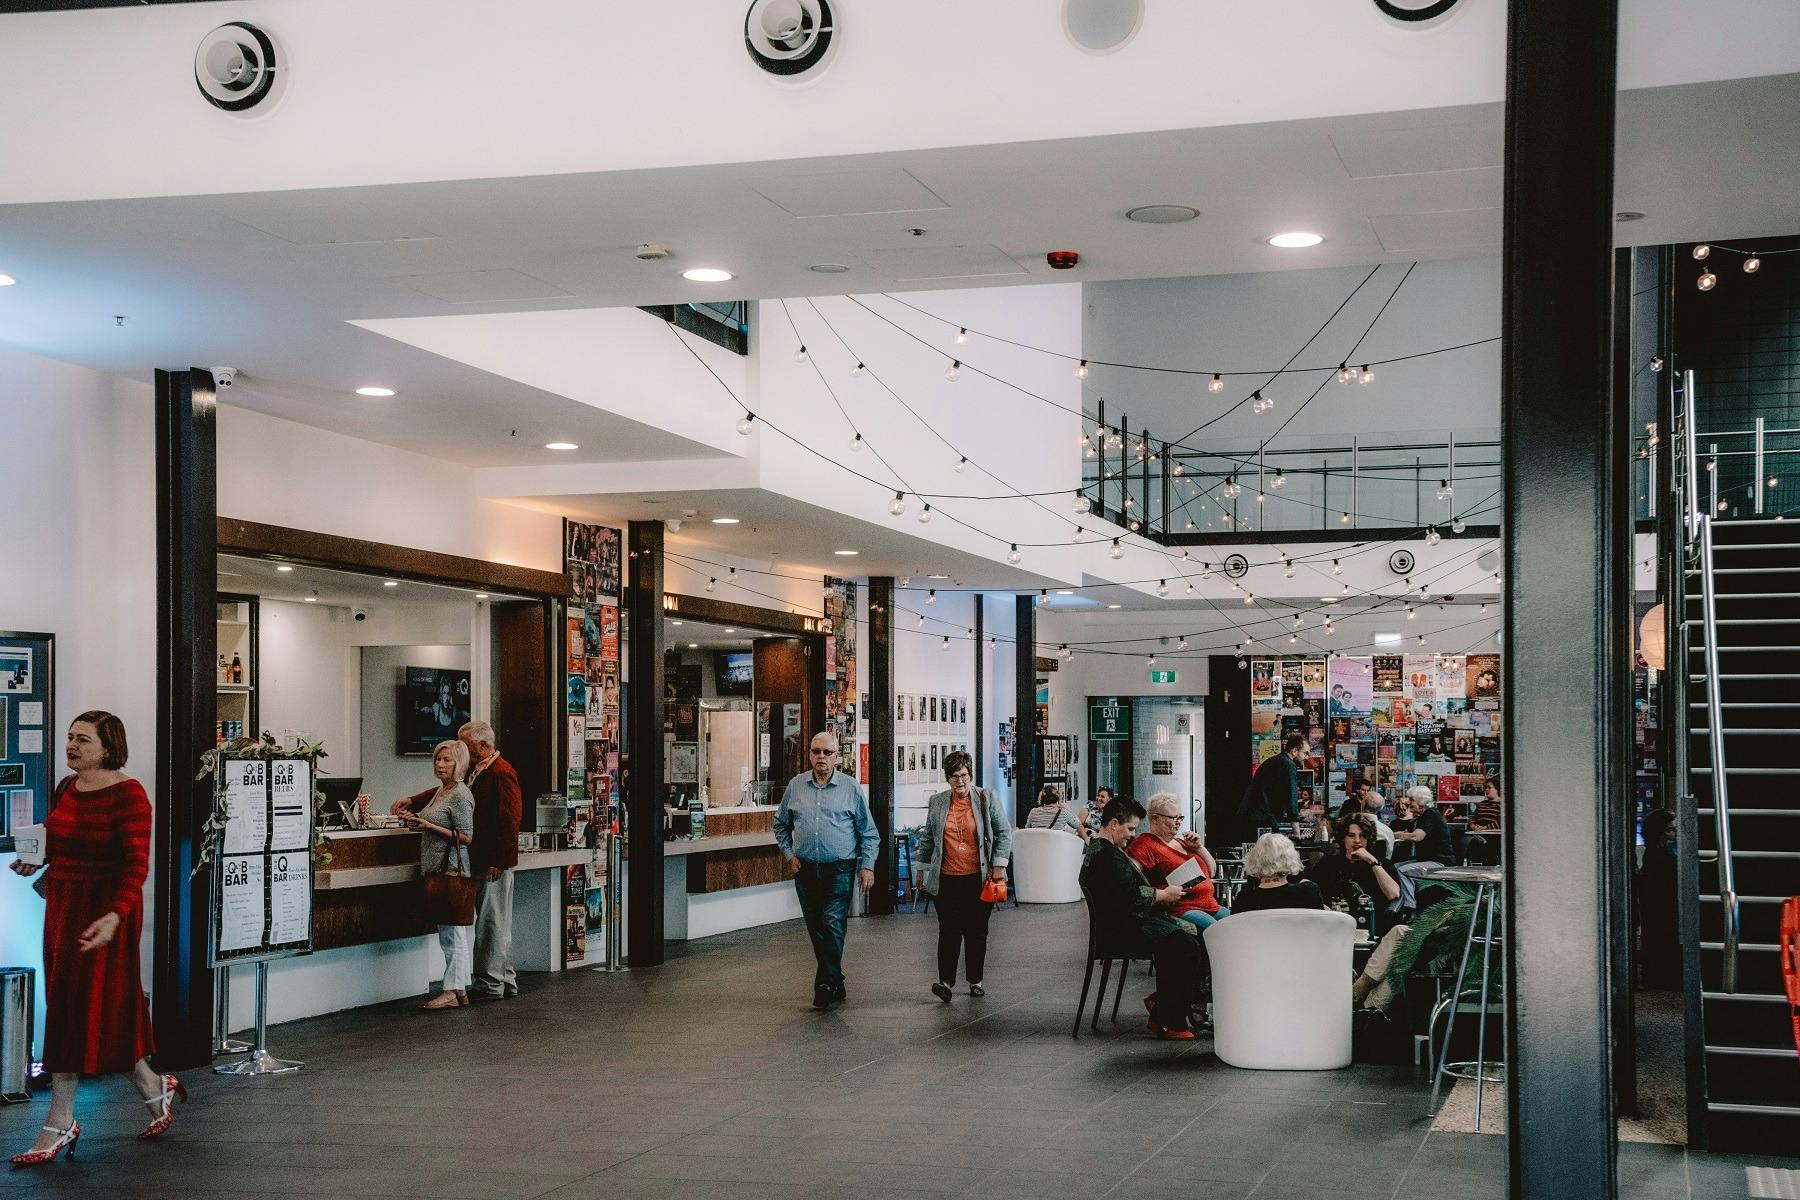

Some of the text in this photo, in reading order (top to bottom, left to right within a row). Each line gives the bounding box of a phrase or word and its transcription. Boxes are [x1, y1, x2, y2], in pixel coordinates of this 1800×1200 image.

[1102, 707, 1120, 718] EXIT
[243, 775, 264, 786] BAR
[274, 775, 294, 785] BAR
[278, 856, 288, 872] Q
[225, 873, 248, 887] BAR
[273, 872, 288, 883] BAR
